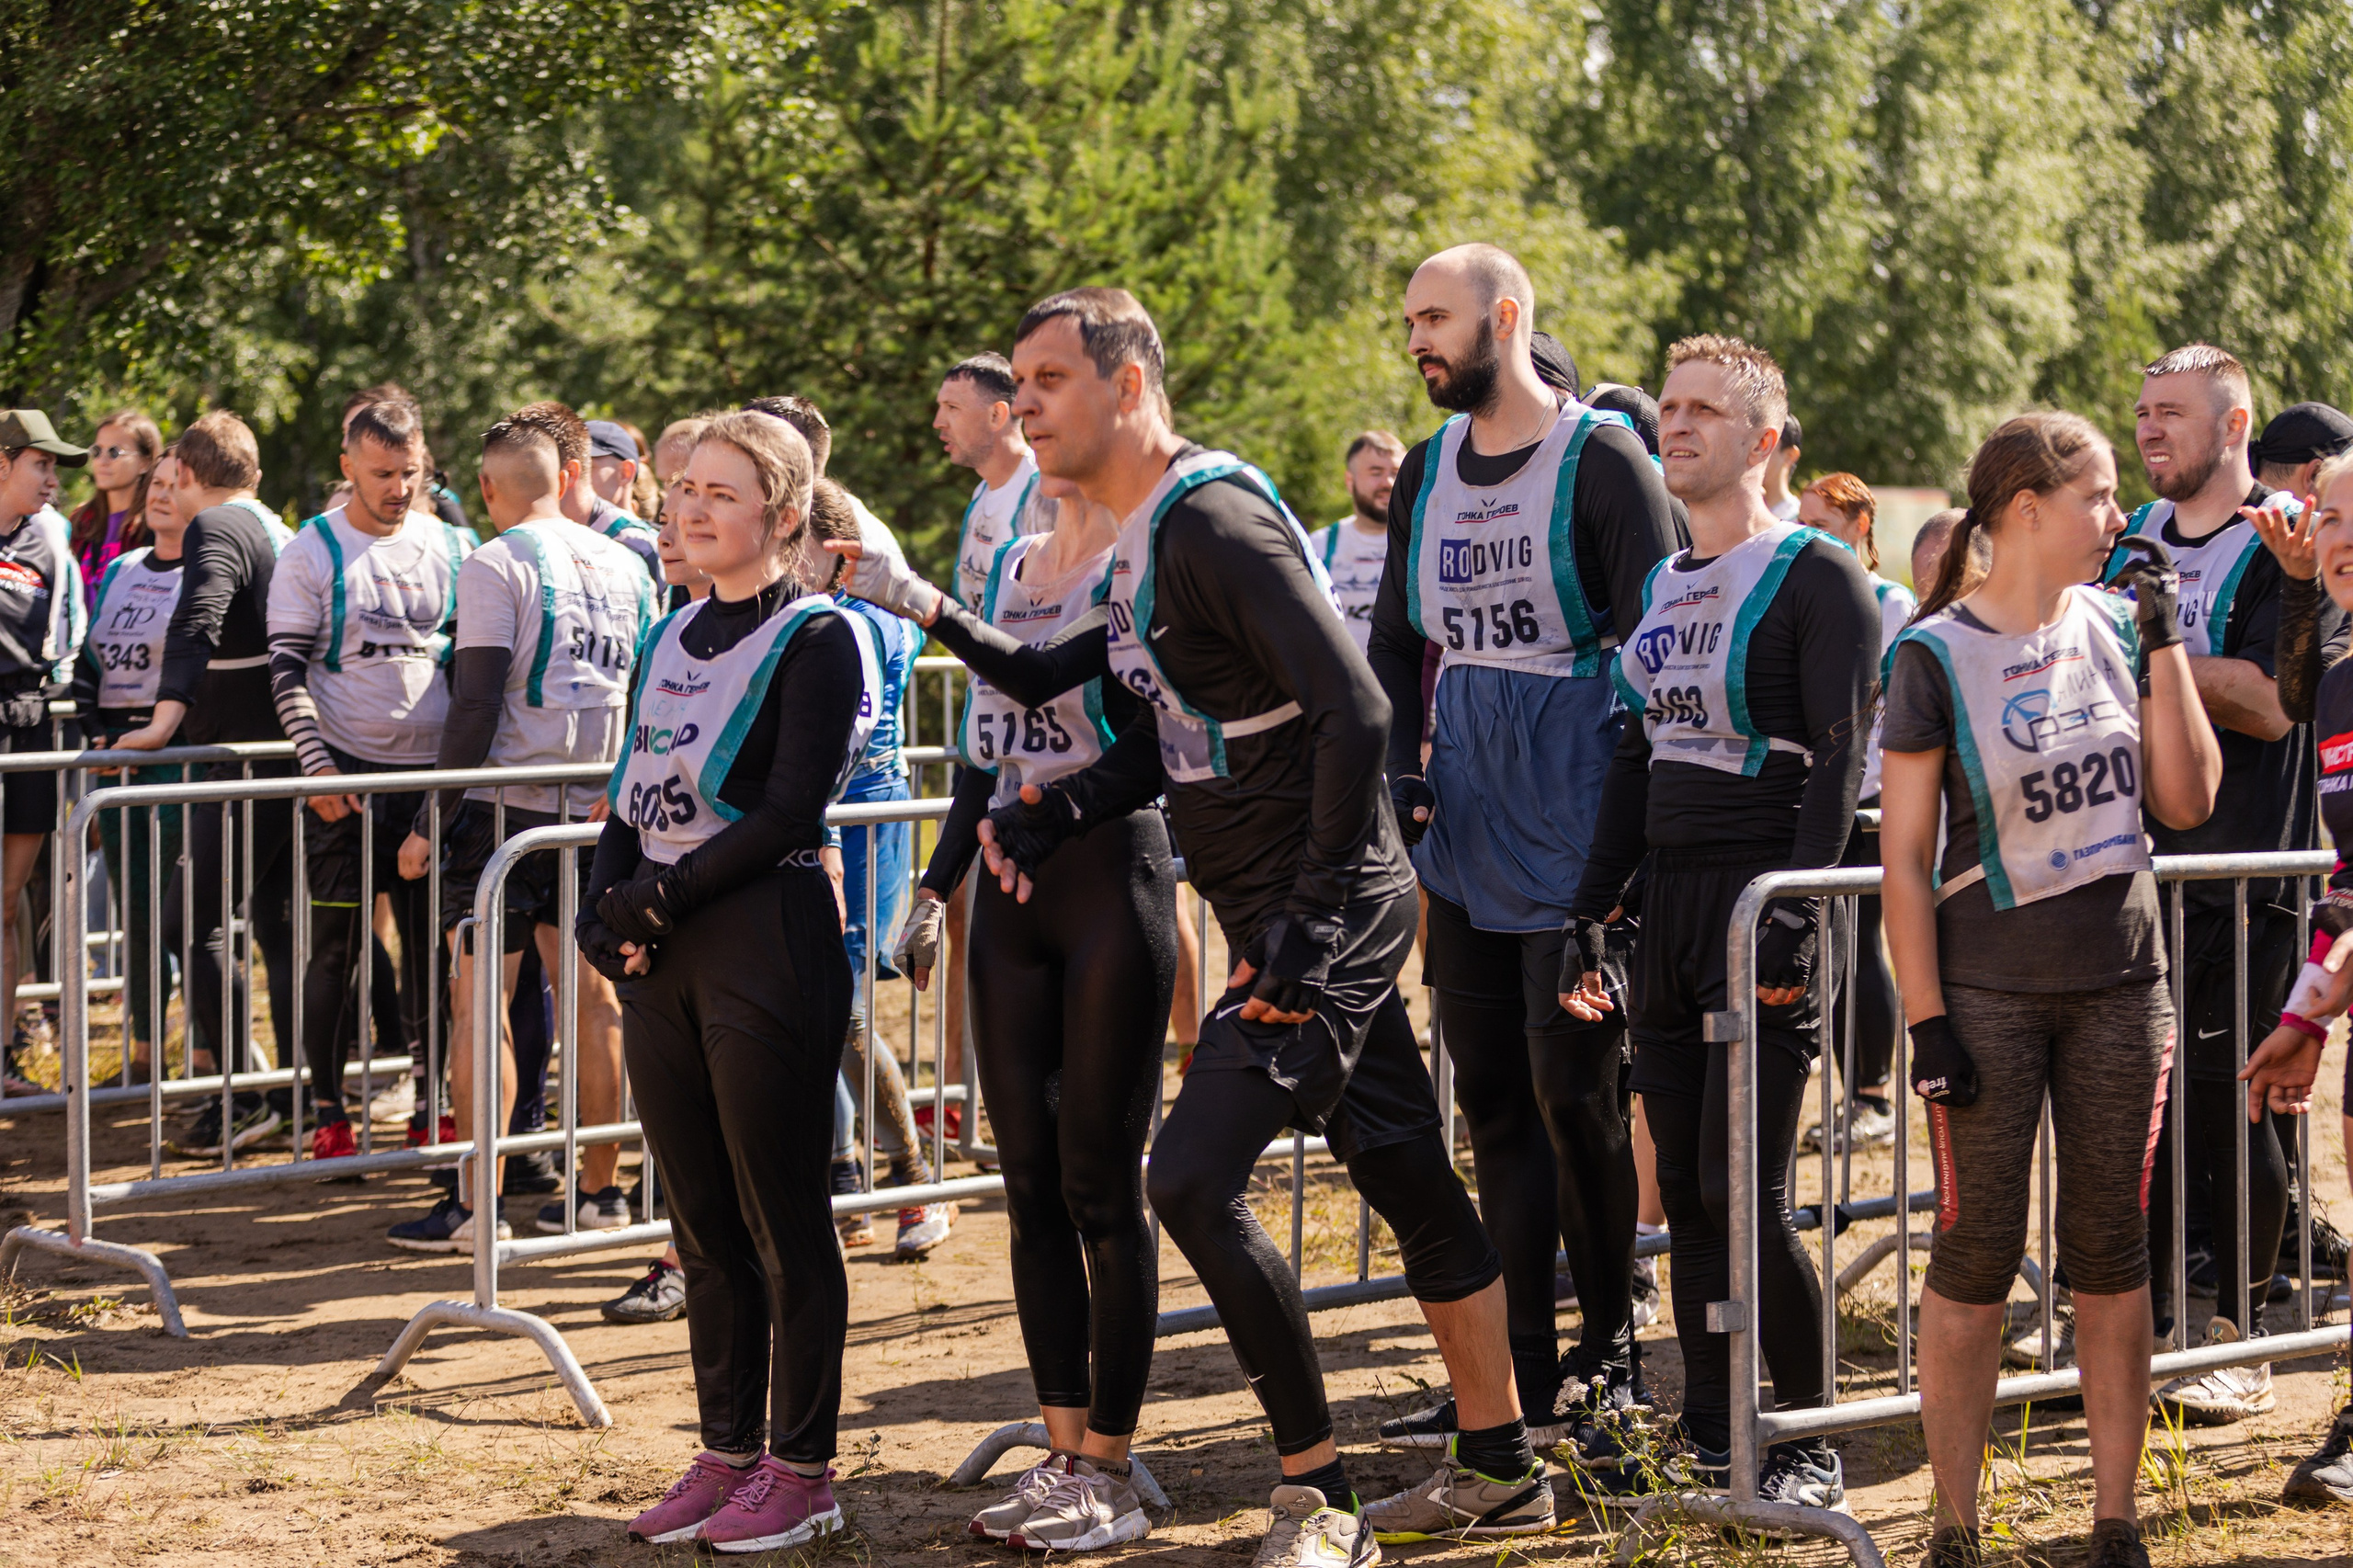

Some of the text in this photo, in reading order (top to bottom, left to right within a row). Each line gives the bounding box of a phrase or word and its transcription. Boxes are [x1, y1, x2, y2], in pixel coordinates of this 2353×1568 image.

[1457, 504, 1518, 520] ГОНКА ГЕРОЕВ
[1441, 535, 1532, 578] RODVIG
[1029, 605, 1062, 618] ГЕРОЕВ
[1442, 599, 1540, 651] 5156
[1637, 622, 1722, 669] ROVIG
[633, 722, 699, 755] BICD
[977, 706, 1073, 760] 5165
[2020, 746, 2135, 824] 5820
[1938, 1125, 1946, 1149] YOUR
